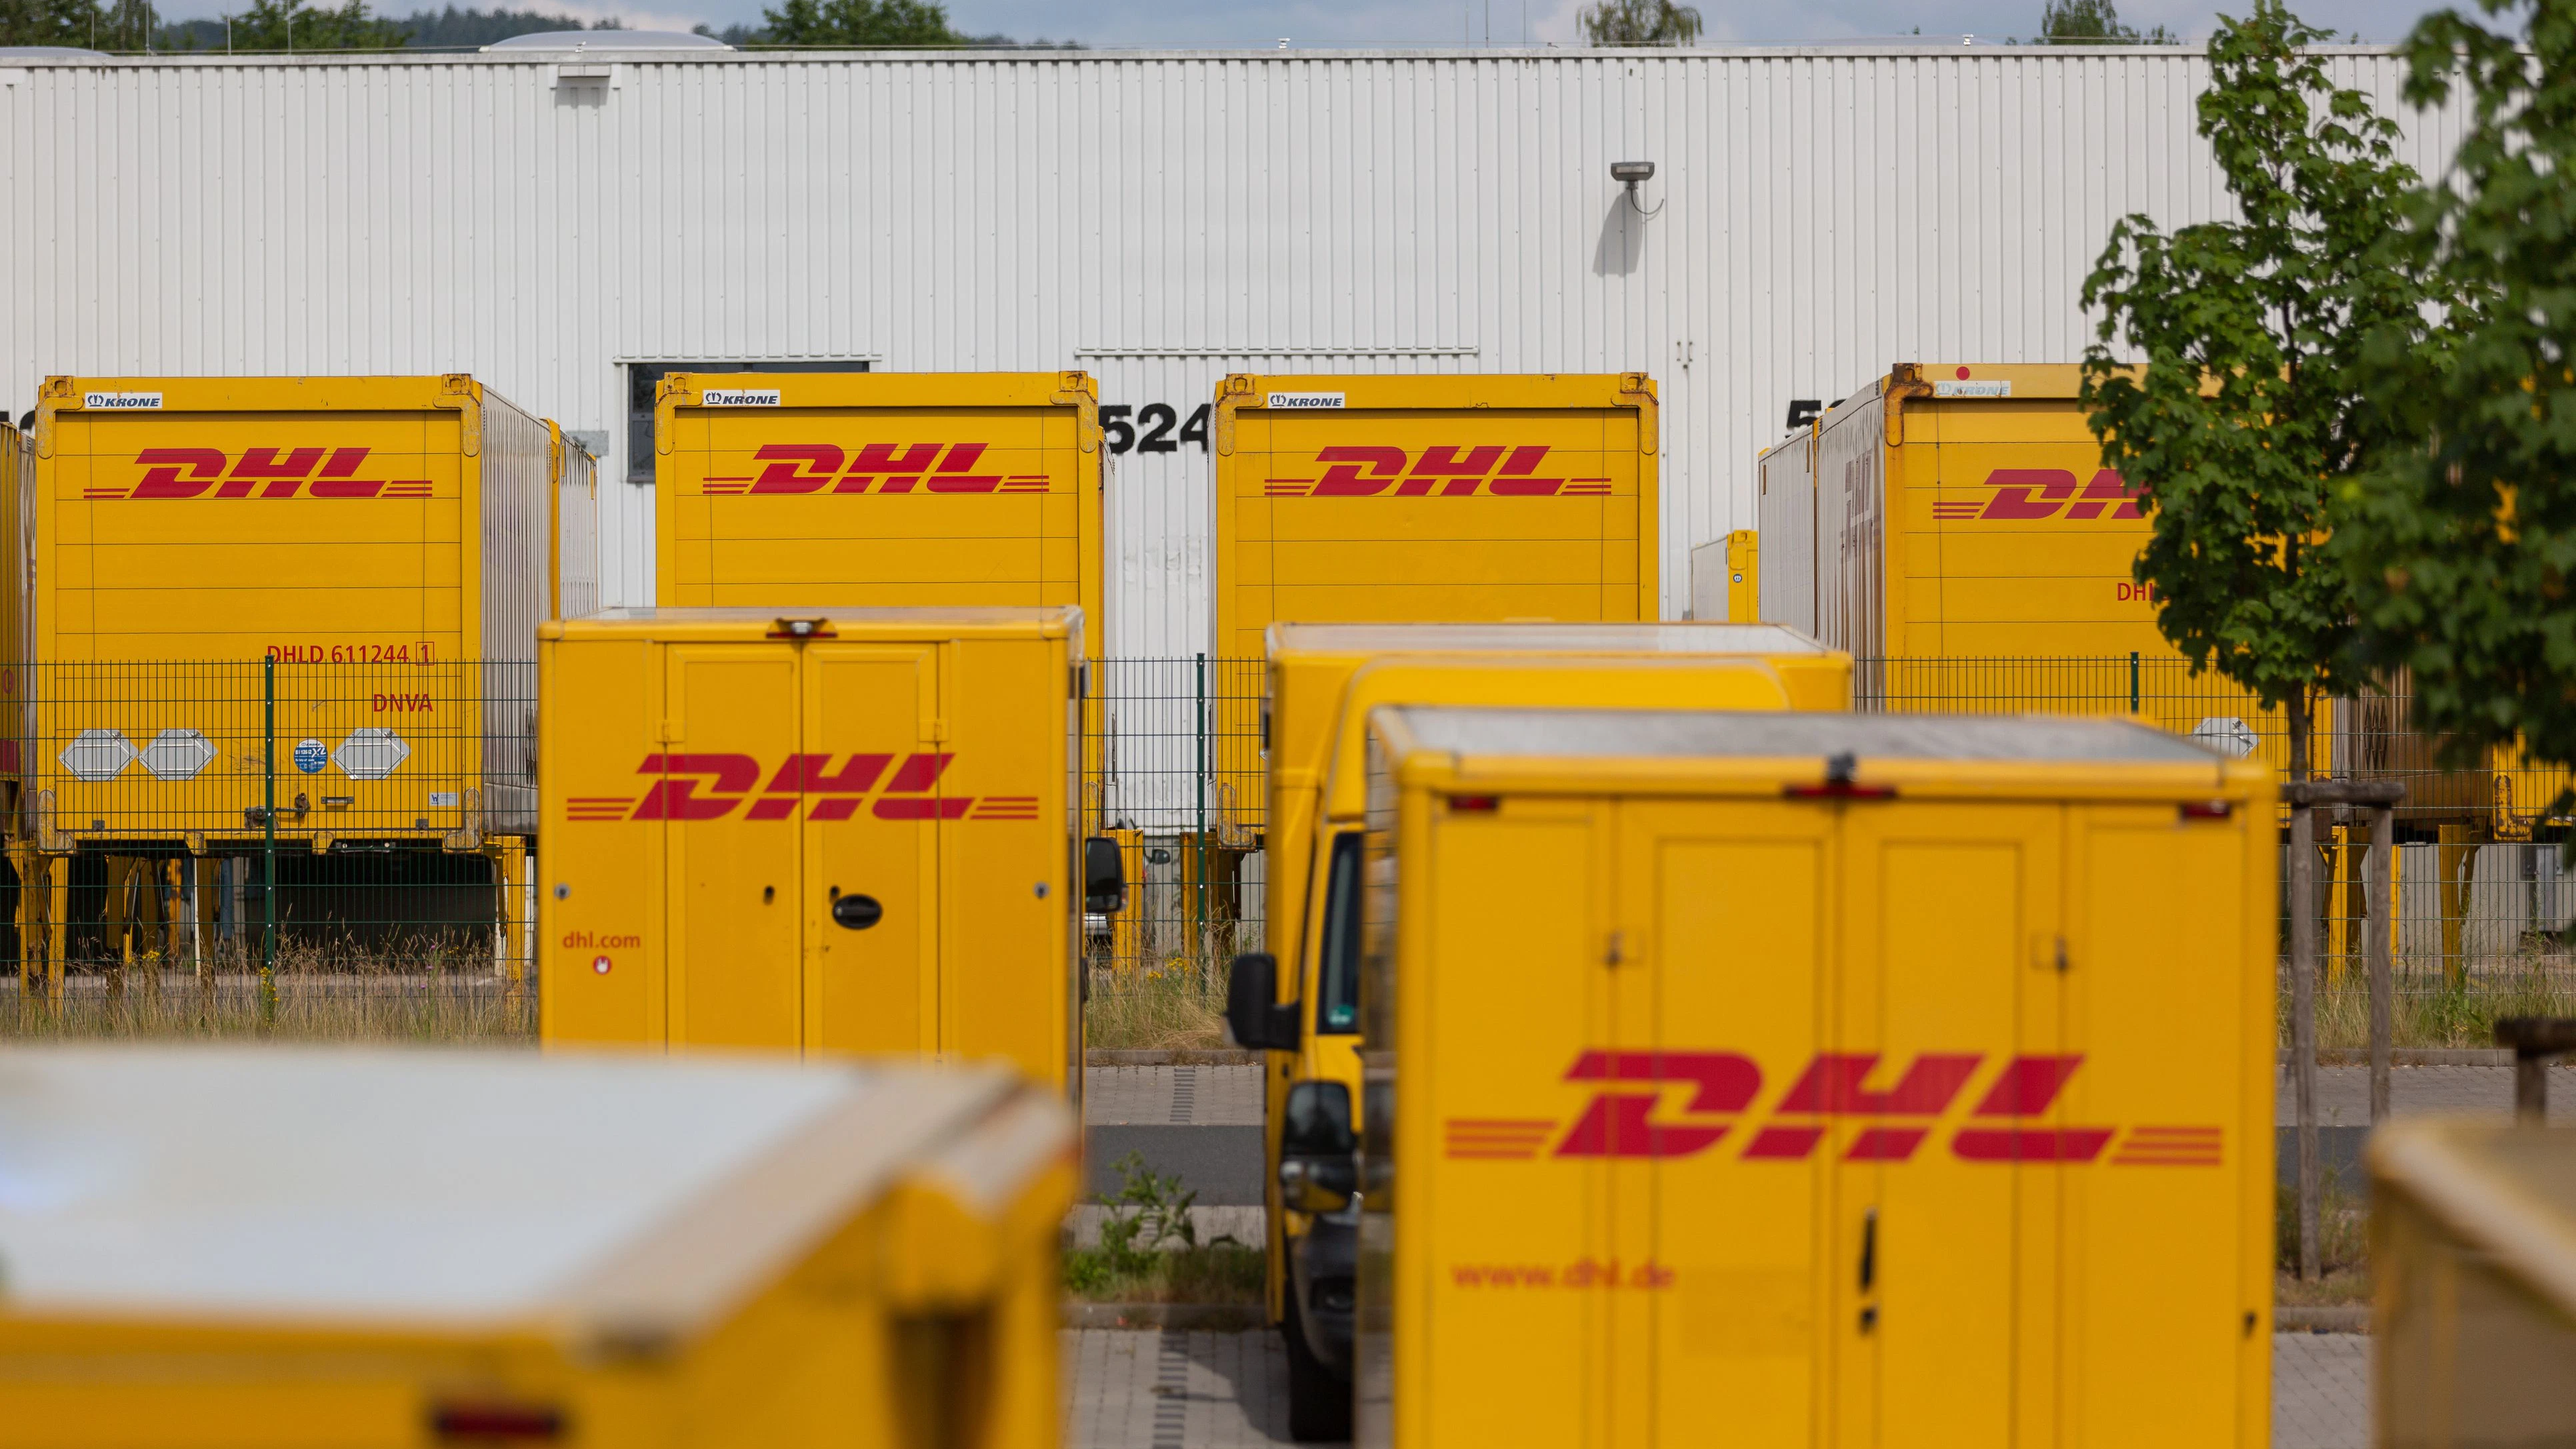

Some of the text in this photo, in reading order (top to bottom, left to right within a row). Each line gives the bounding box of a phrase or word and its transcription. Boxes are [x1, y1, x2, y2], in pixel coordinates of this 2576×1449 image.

[105, 398, 160, 407] KRONE
[723, 395, 778, 404] KRONE
[1287, 398, 1343, 407] KRONE
[1099, 403, 1211, 455] 524
[129, 448, 387, 499] DHL
[748, 443, 1004, 494] DHL
[1310, 445, 1566, 497] DHL
[1979, 469, 2152, 519] DH
[267, 645, 324, 663] DHLD
[331, 645, 409, 664] 611244
[373, 693, 433, 712] DNVA
[631, 752, 976, 822] DHL
[563, 931, 641, 948] dhl.com
[1552, 1048, 2117, 1166] DHL
[1449, 1256, 1676, 1288] www.dhl.de
